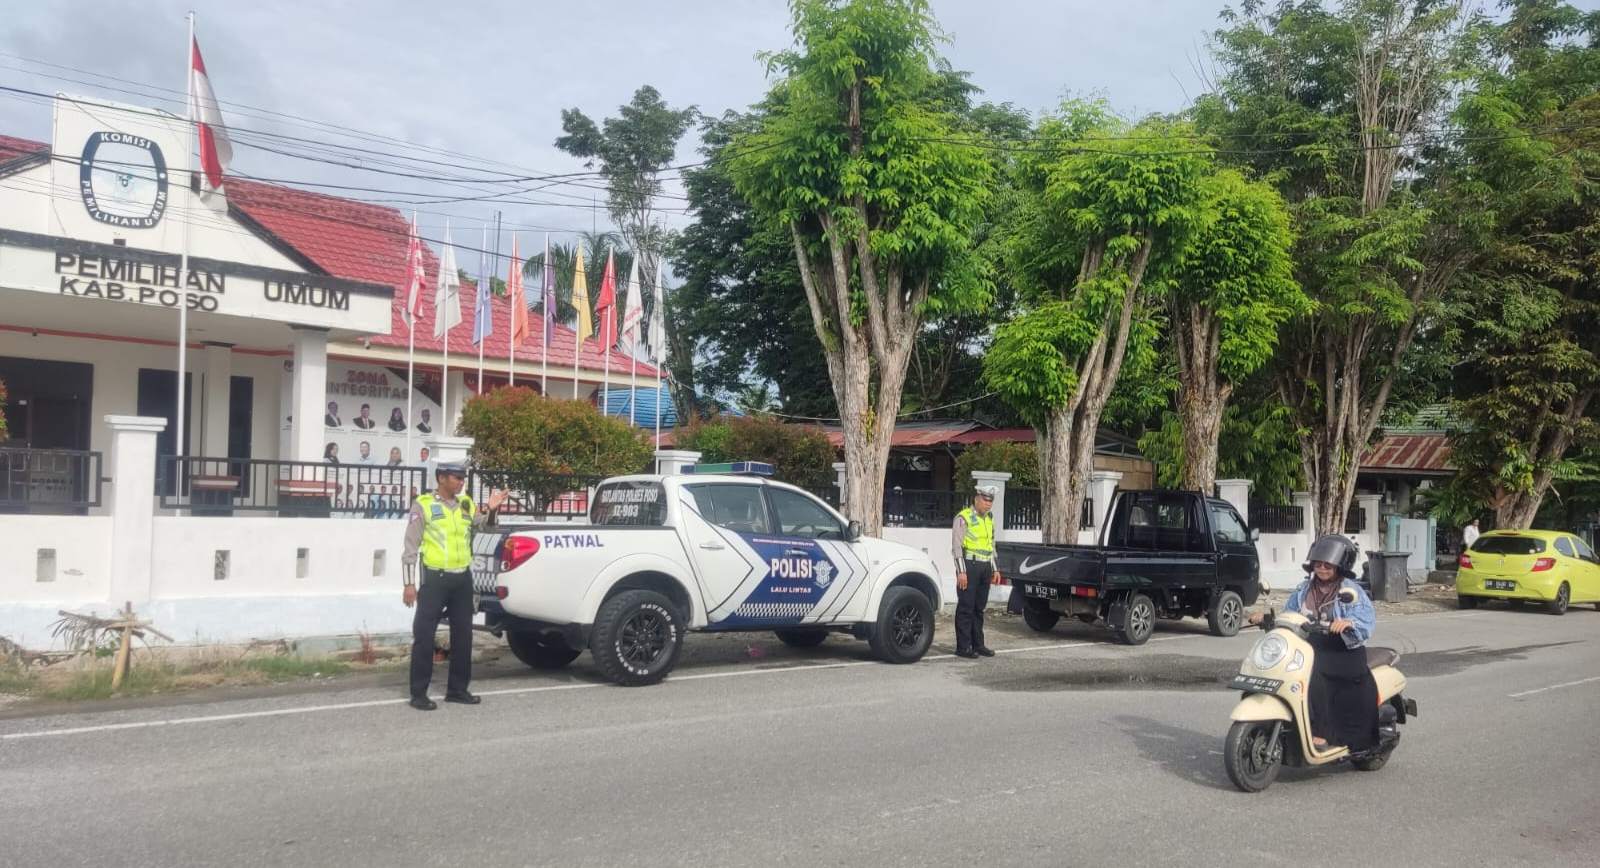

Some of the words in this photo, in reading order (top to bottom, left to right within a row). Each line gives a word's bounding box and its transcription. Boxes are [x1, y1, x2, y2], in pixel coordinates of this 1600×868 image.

[101, 132, 151, 149] KOMISI
[82, 180, 140, 226] PEMILIHAN
[144, 191, 167, 225] UMUM
[55, 253, 225, 294] PEMILIHAN
[264, 280, 350, 311] UMUM
[347, 370, 389, 386] ZONA
[644, 487, 658, 503] POSO
[544, 534, 604, 549] PATWAL
[771, 558, 813, 579] POLISI
